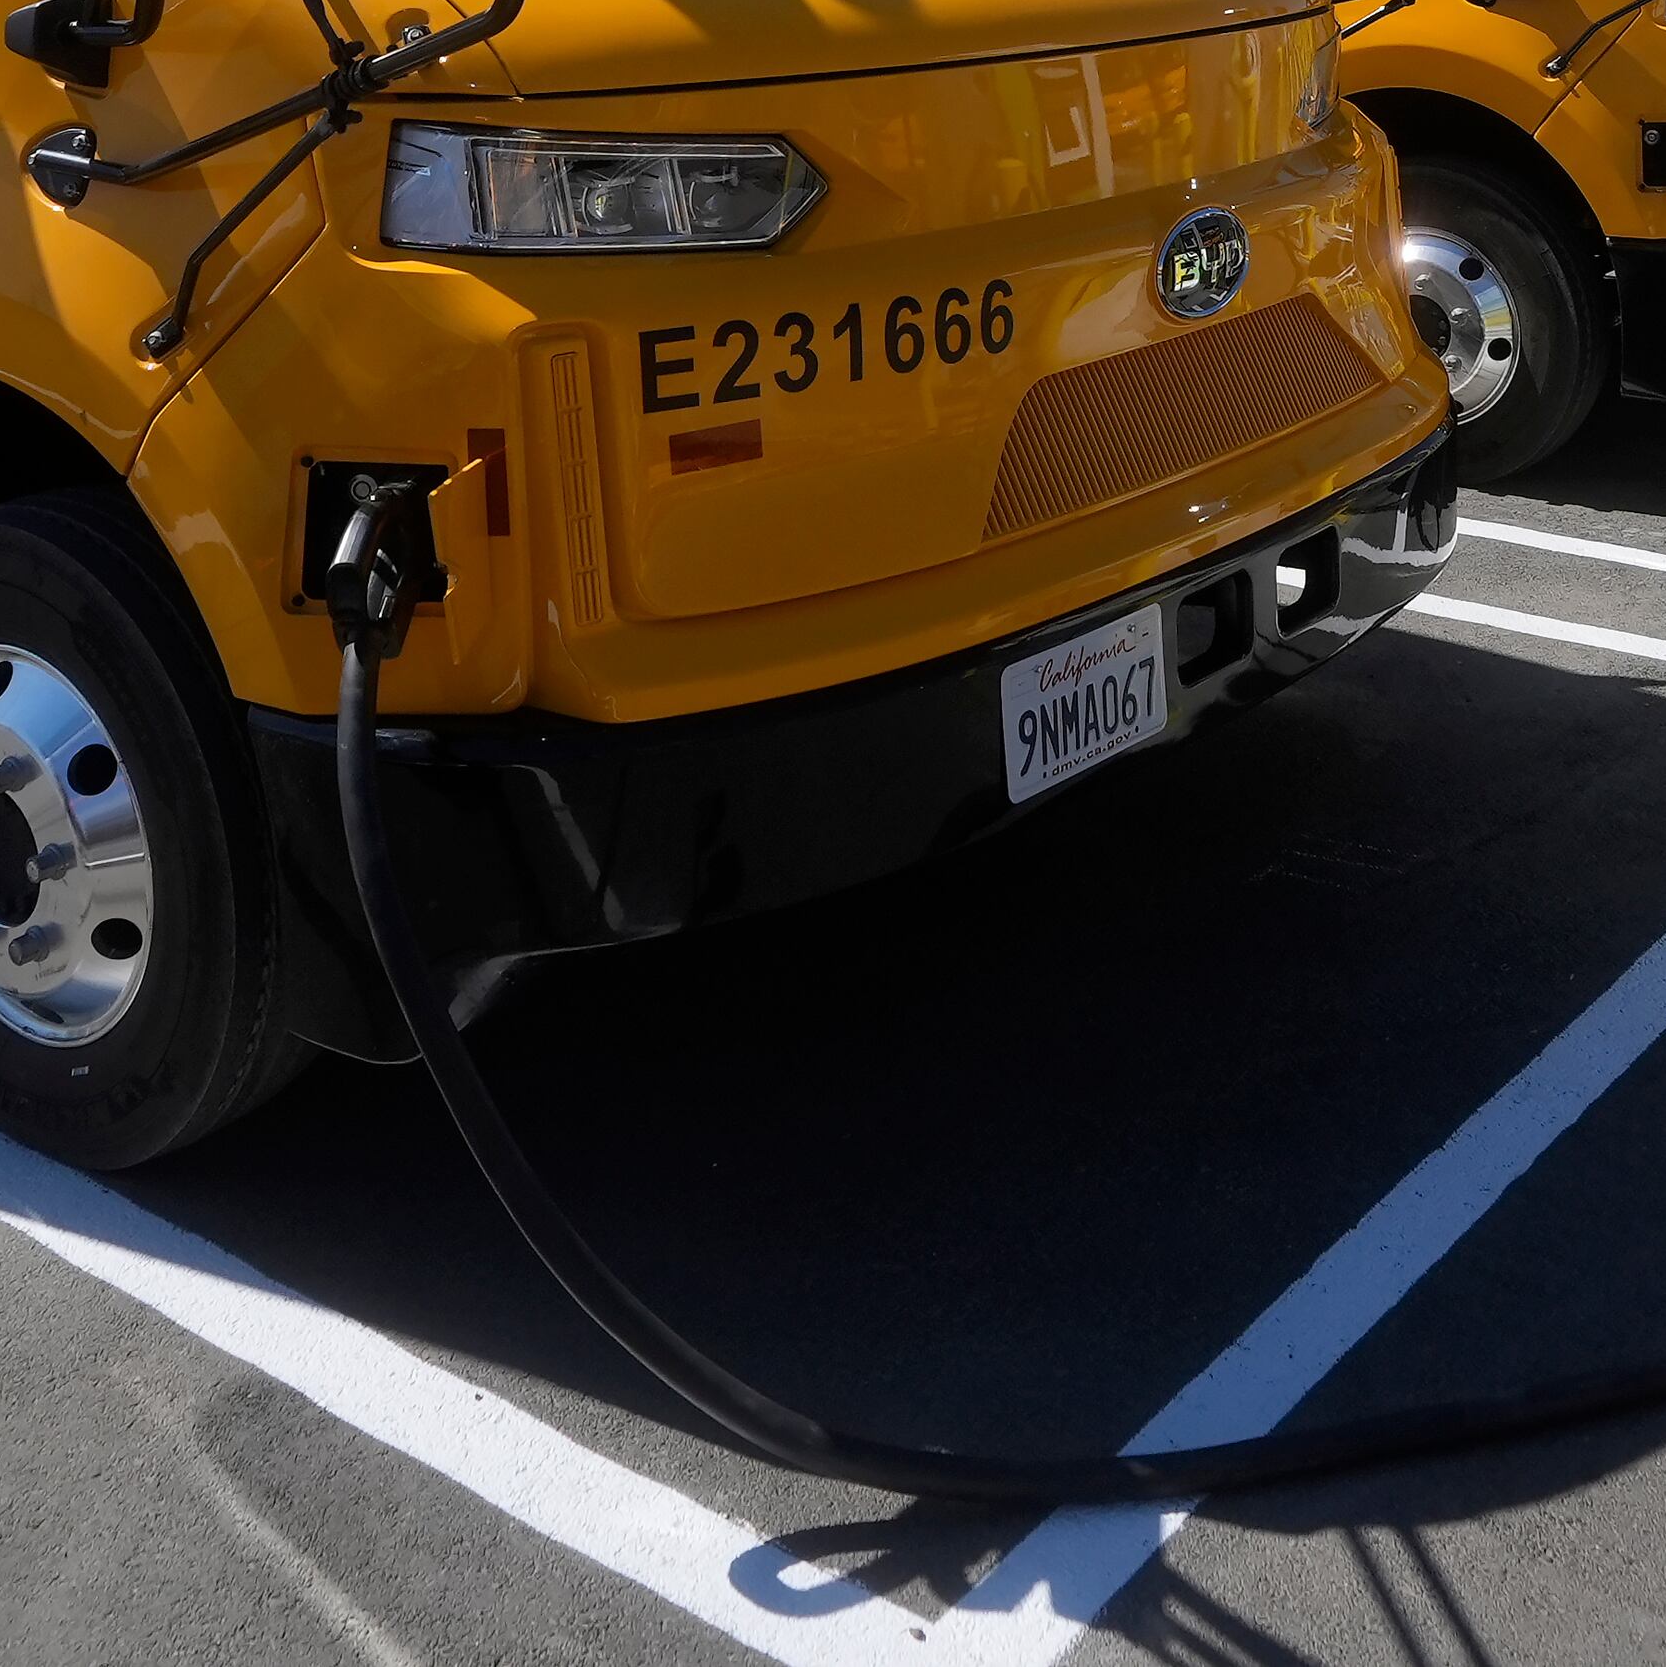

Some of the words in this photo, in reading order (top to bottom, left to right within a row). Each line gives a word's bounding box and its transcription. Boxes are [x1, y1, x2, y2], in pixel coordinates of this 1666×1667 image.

[1172, 239, 1245, 292] BYD
[637, 279, 1016, 415] E231666
[1039, 634, 1137, 693] California
[1018, 655, 1156, 778] 9NMA067
[1051, 730, 1133, 777] dmv.ca.gov
